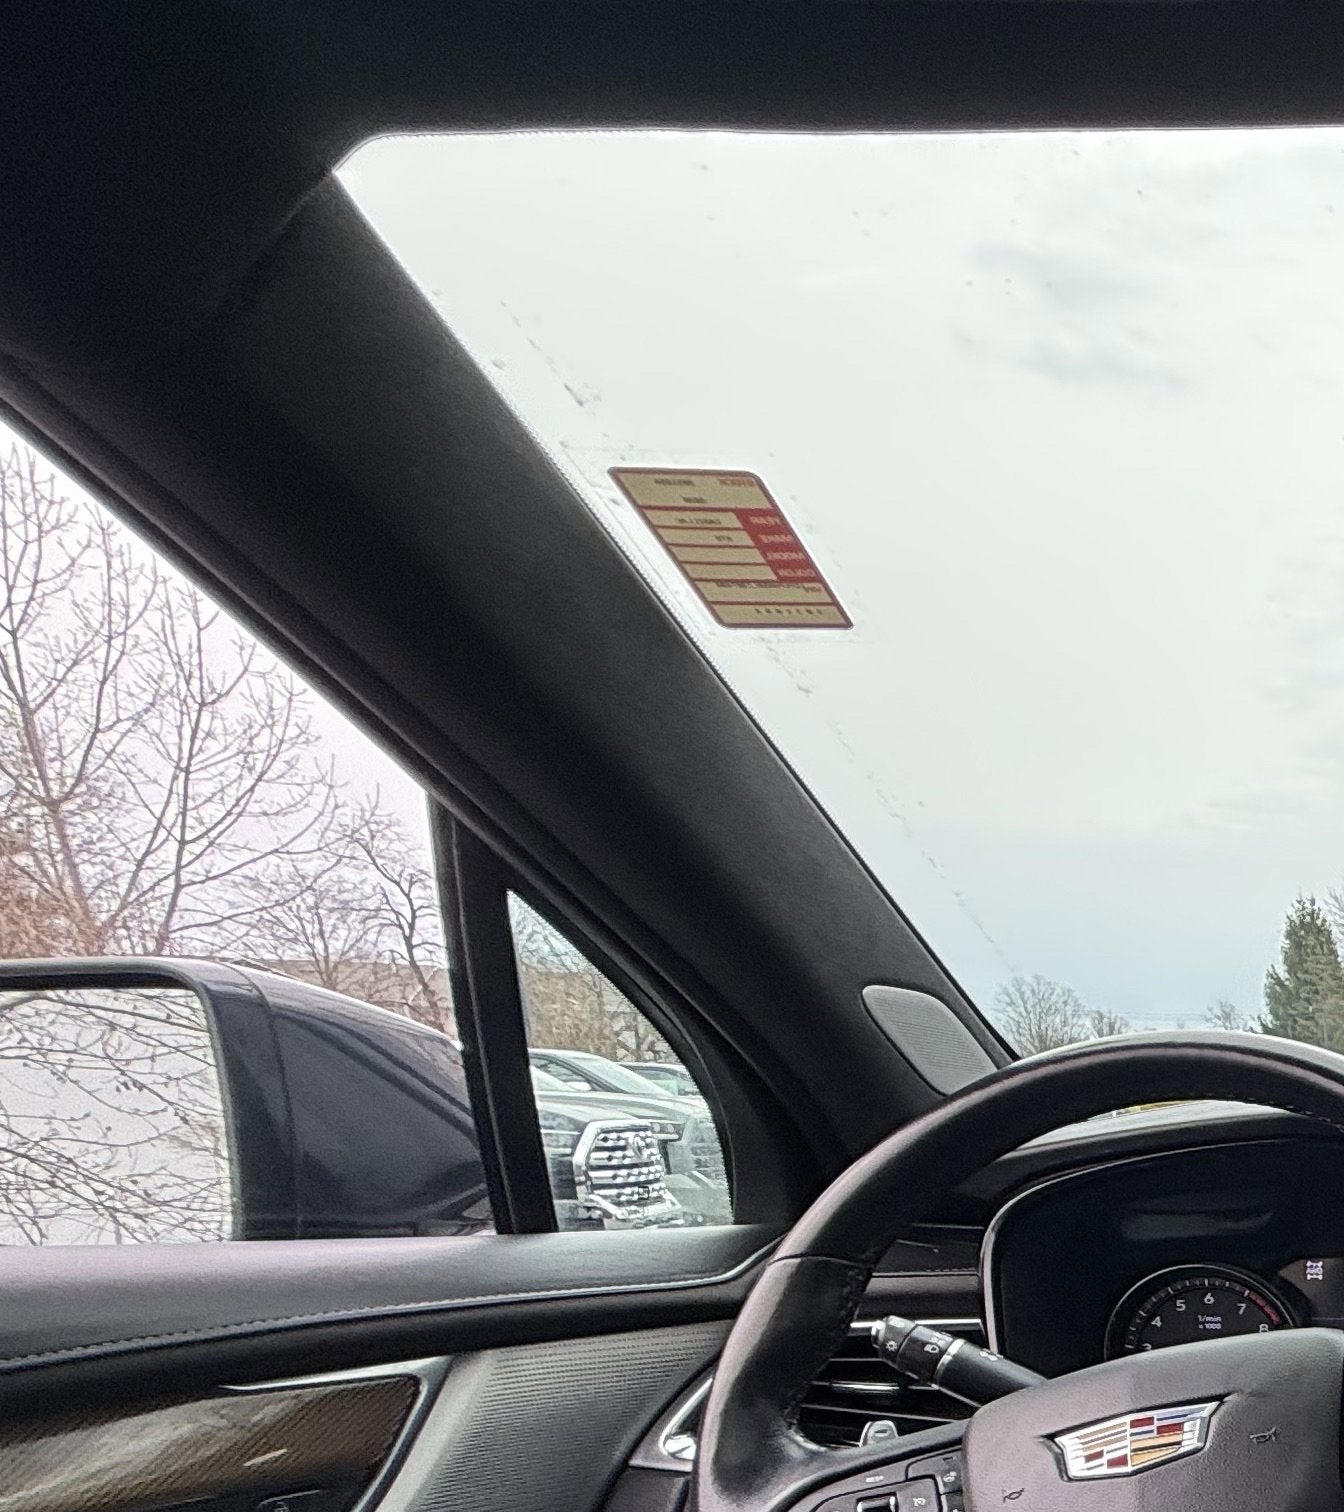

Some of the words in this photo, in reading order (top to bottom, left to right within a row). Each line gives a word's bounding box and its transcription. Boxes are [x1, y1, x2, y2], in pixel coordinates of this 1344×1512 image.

[1204, 1293, 1215, 1304] 6
[1176, 1300, 1186, 1311] 5
[1237, 1303, 1246, 1315] 7
[1151, 1316, 1162, 1327] 4
